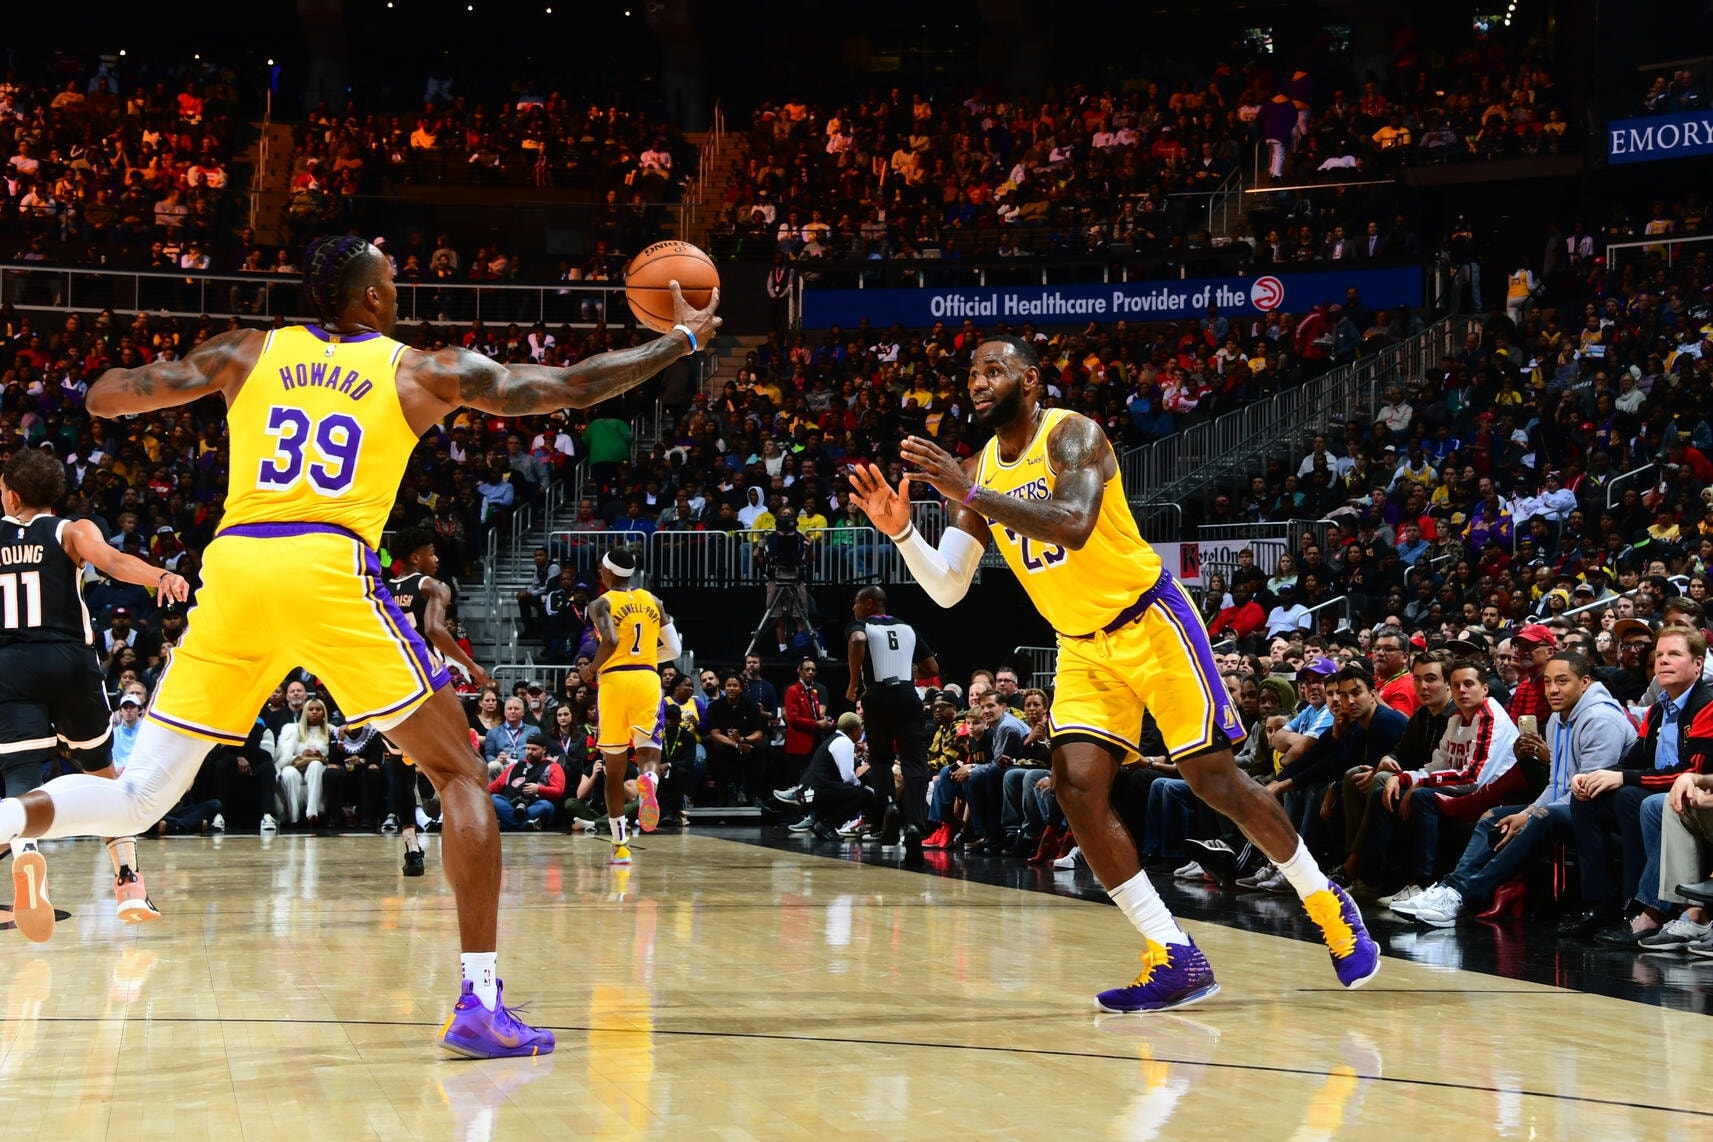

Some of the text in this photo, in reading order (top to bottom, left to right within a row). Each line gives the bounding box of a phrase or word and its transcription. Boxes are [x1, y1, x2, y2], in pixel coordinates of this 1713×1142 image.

[1611, 120, 1713, 154] EMORY
[930, 283, 1245, 317] Official Healthcare Provider of the
[279, 362, 373, 401] HOWARD
[257, 406, 364, 498] 39
[0, 545, 44, 567] OUNG
[1182, 546, 1239, 574] Ketel On
[0, 571, 42, 628] 11
[393, 595, 414, 607] DISH
[631, 622, 642, 655] 1
[886, 630, 899, 651] 6
